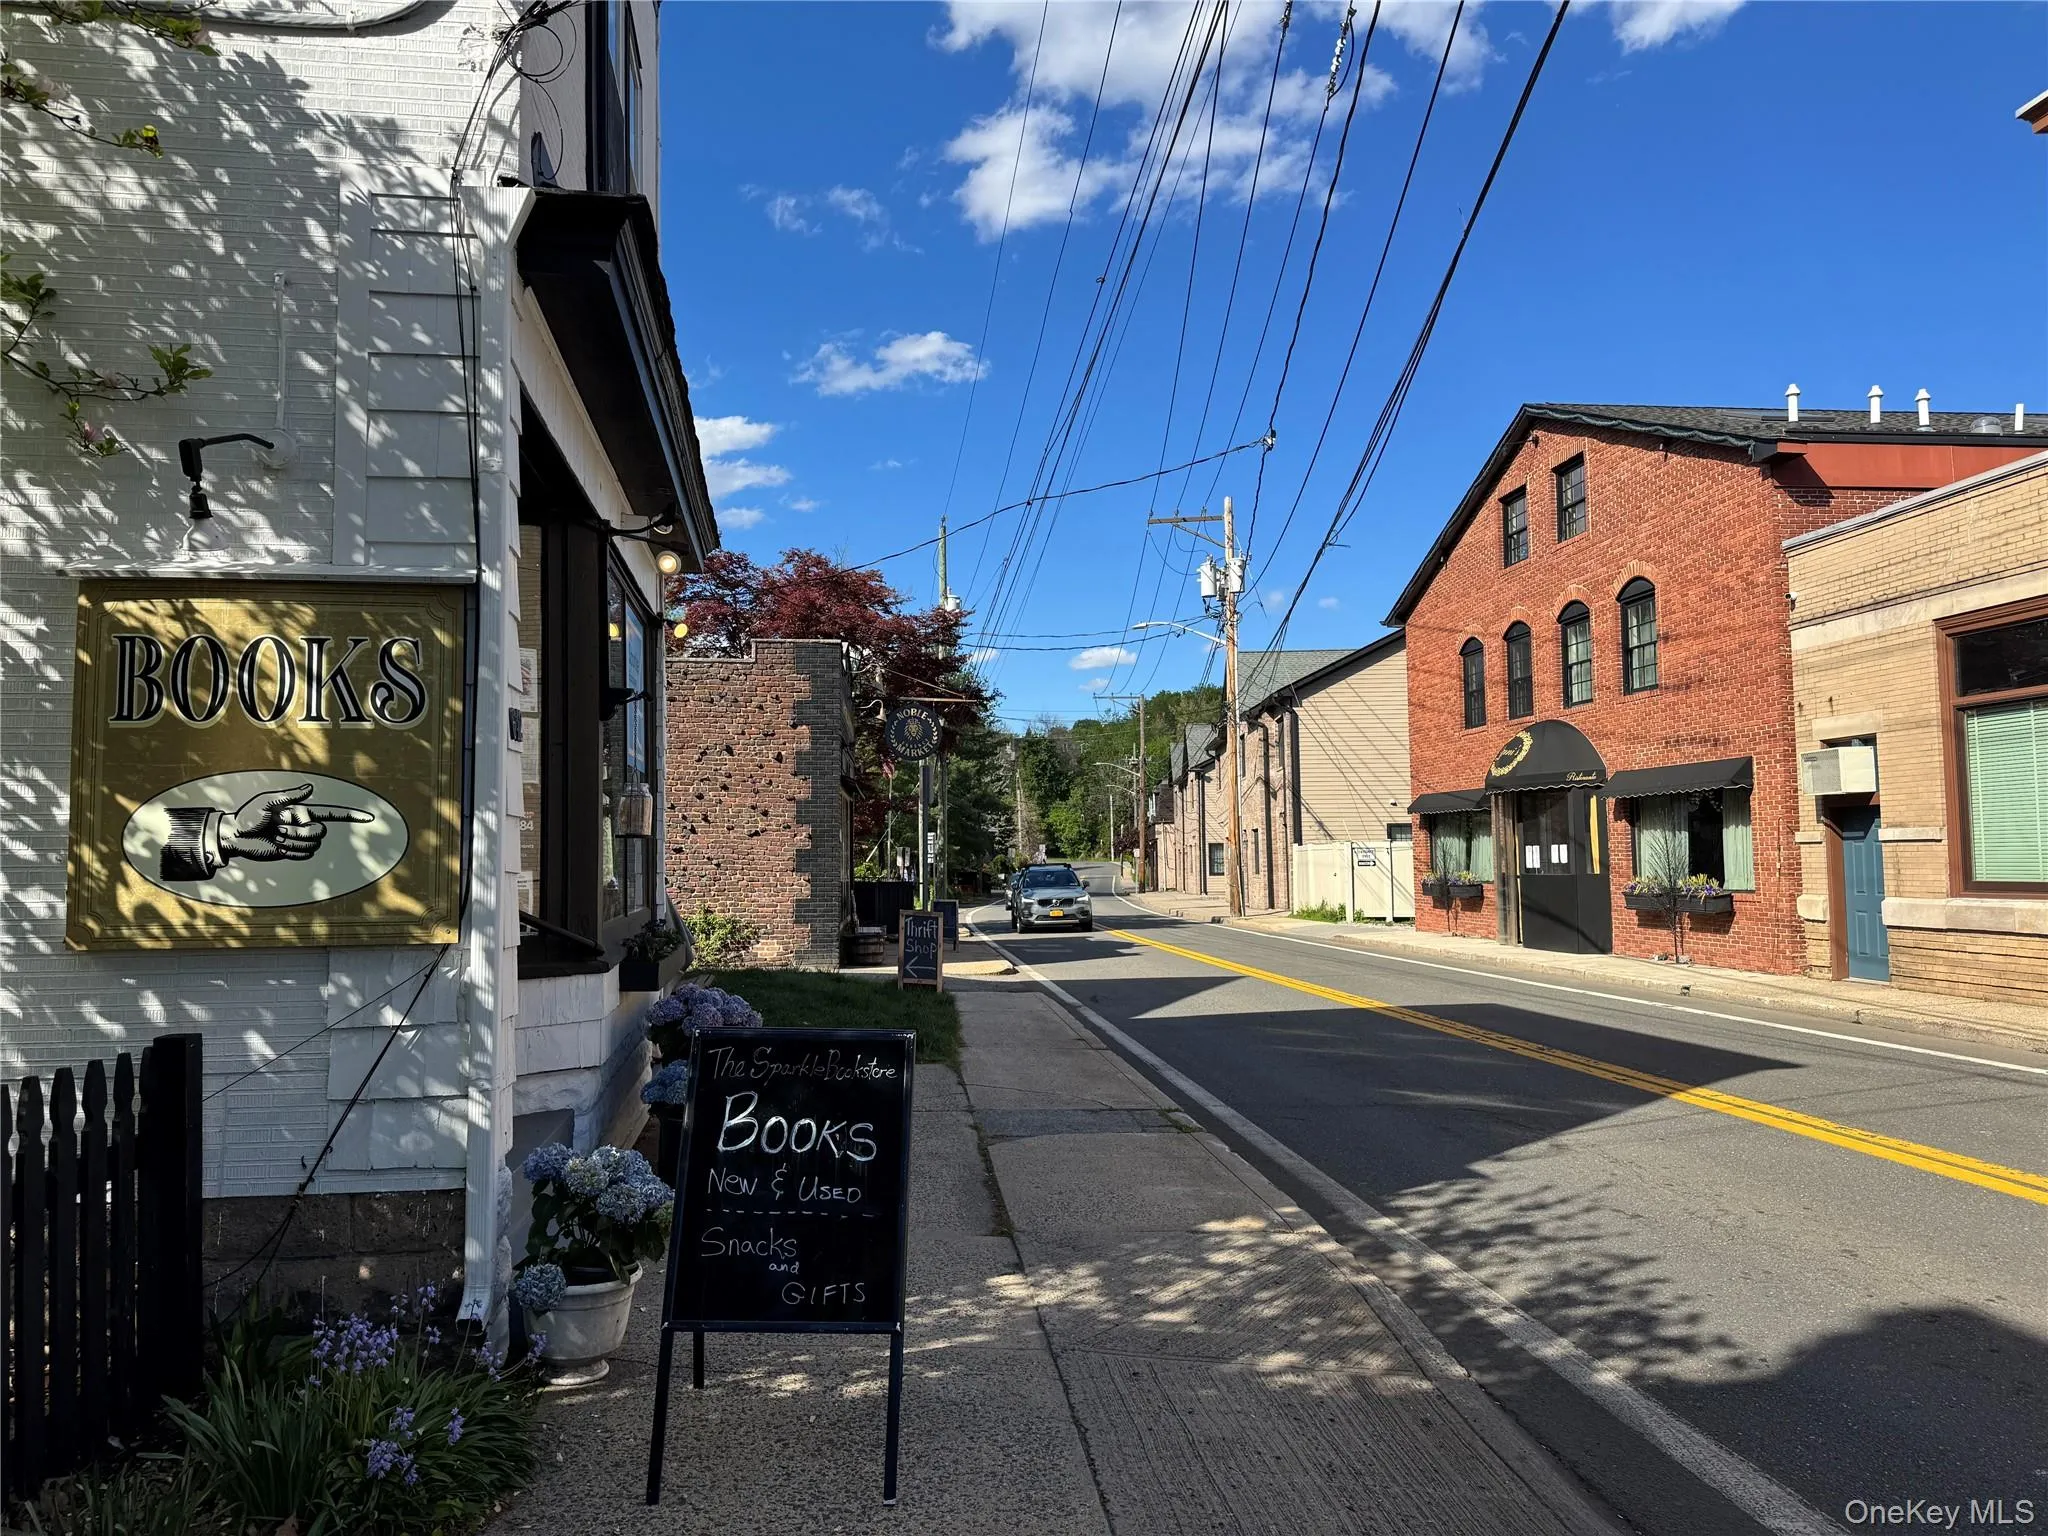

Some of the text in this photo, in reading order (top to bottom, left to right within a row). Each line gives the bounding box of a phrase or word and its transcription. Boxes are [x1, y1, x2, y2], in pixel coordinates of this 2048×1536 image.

[108, 633, 428, 729] BOOKS
[896, 708, 929, 720] NOBLE
[895, 742, 934, 757] MARKET
[904, 916, 938, 939] Thrift
[905, 938, 938, 960] Shop
[708, 1046, 746, 1080] The
[750, 1046, 825, 1087] Sparkle
[771, 1162, 788, 1200] &
[701, 1226, 797, 1260] Snacks
[768, 1261, 800, 1275] and
[781, 1282, 866, 1306] GIFTS
